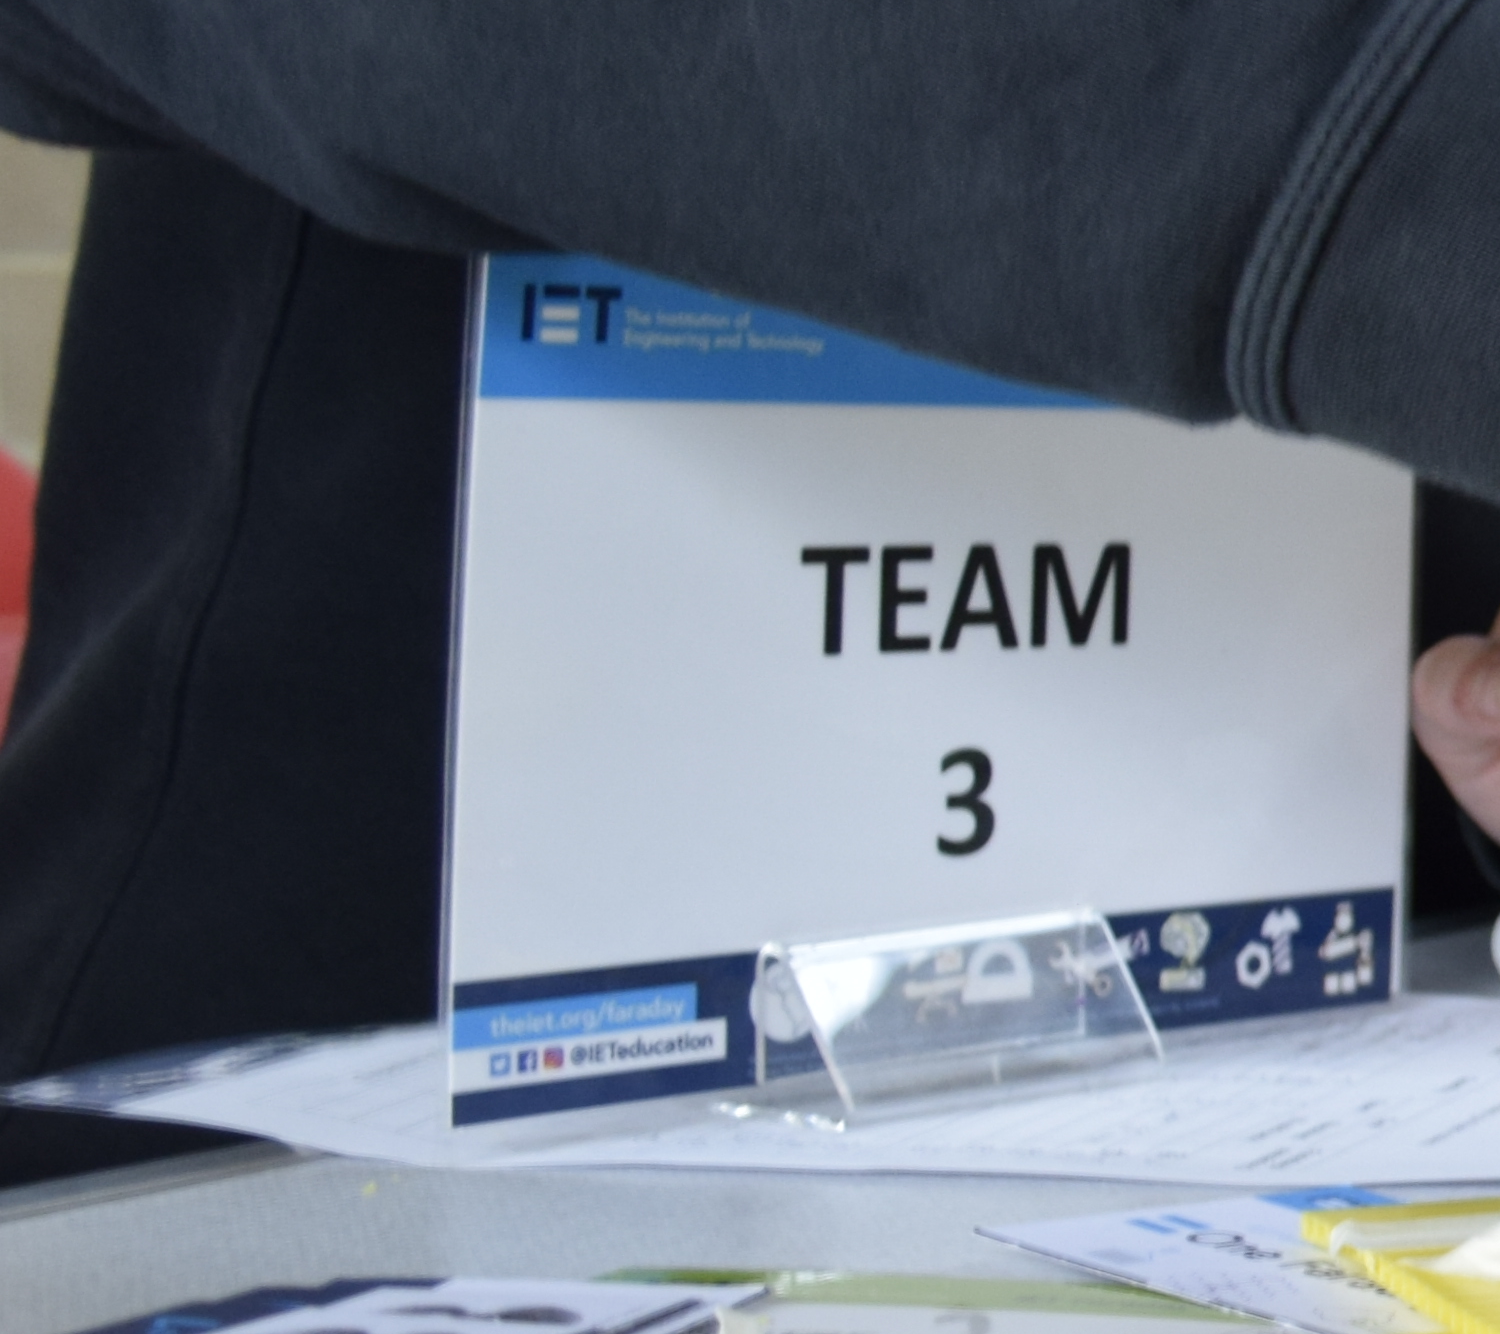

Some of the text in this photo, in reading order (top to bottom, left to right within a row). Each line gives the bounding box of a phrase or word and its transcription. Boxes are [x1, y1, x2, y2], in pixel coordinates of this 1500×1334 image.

[521, 283, 623, 344] IET
[801, 543, 1131, 655] TEAM
[936, 749, 995, 855] 3
[490, 995, 685, 1038] theiet.org/faraday
[570, 1031, 714, 1066] @IETeducation
